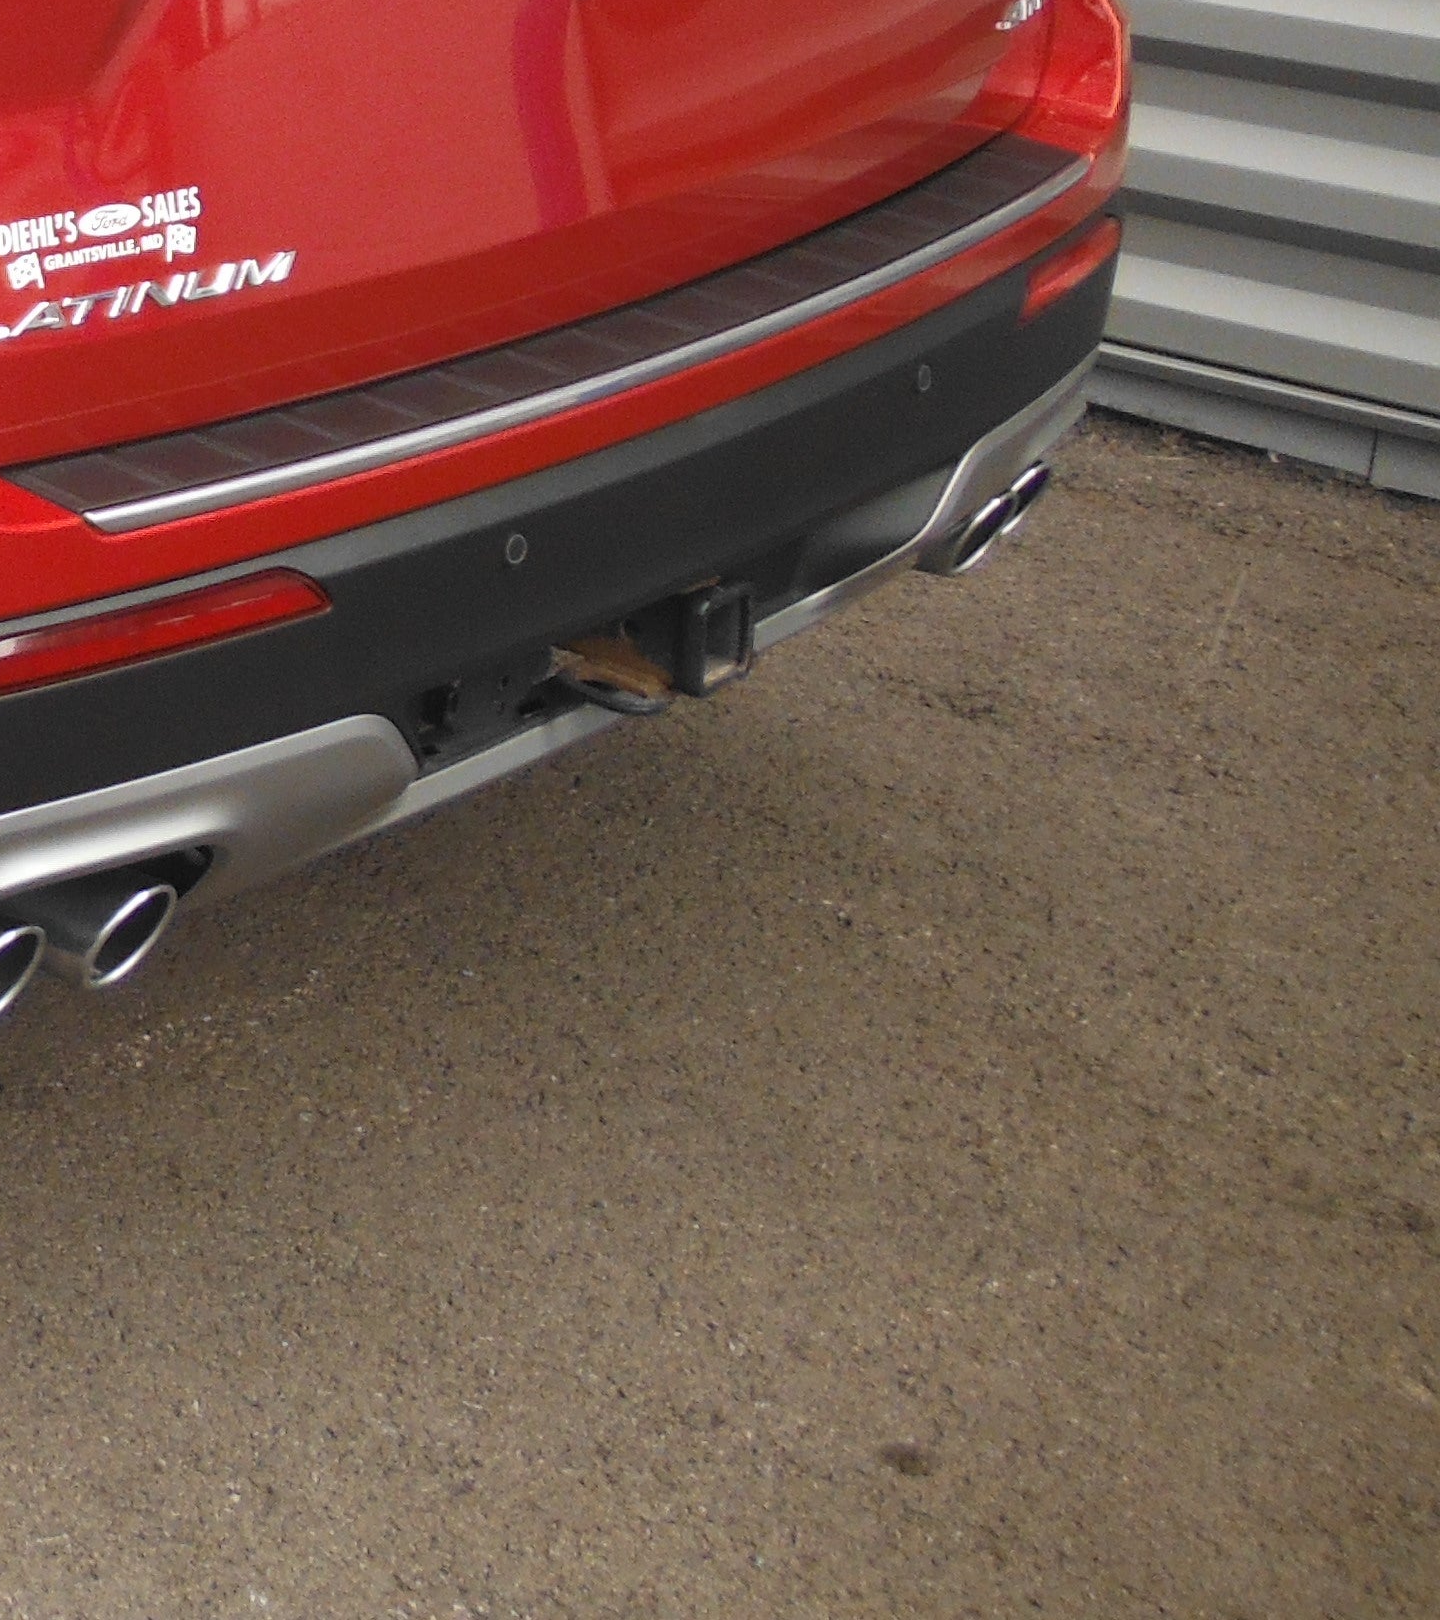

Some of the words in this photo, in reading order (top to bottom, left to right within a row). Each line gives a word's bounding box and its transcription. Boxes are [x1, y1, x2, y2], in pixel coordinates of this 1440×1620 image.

[91, 209, 128, 232] Ford
[141, 186, 201, 227] SALES
[43, 238, 140, 271] GRANTSVILLE,
[140, 233, 164, 251] MD
